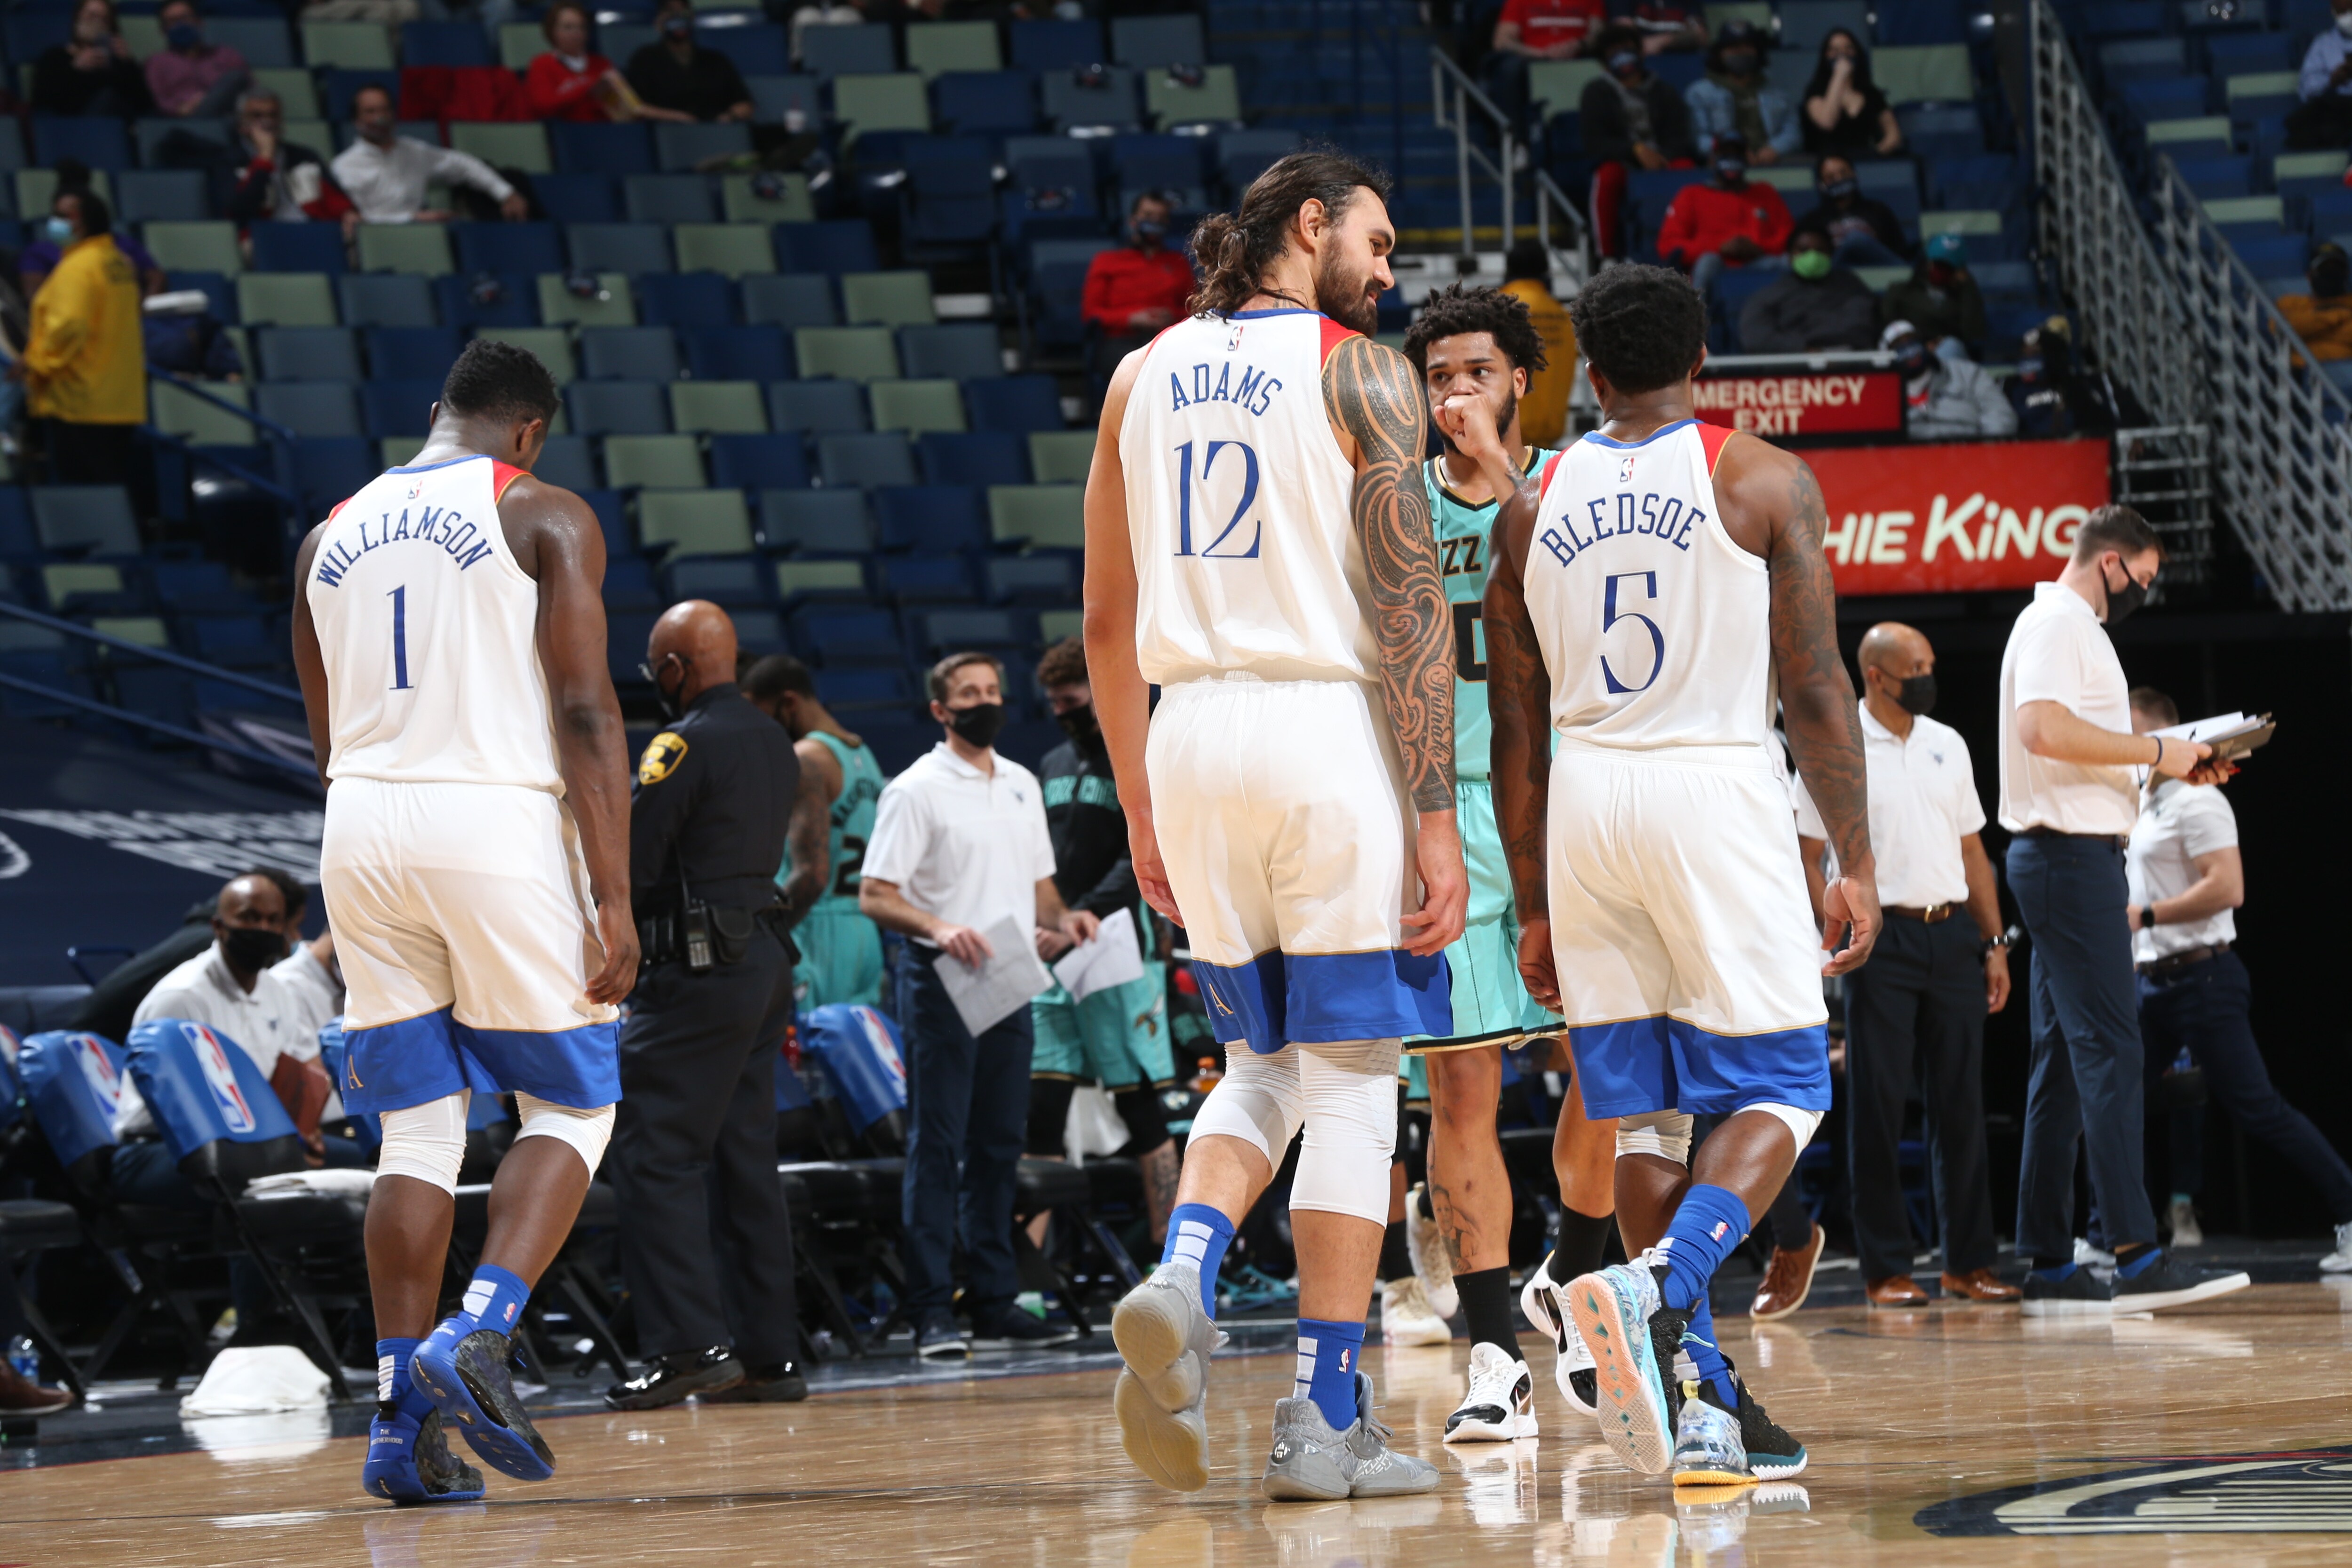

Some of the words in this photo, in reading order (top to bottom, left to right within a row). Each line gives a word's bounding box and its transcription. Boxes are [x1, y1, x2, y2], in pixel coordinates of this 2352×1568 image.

[1170, 361, 1283, 416] ADAMS
[1733, 406, 1804, 436] EXIT
[1173, 439, 1262, 559] 12
[1539, 492, 1707, 568] BLEDSOE
[316, 505, 493, 589] WILLIAMSON
[386, 583, 414, 690] 1
[1598, 569, 1665, 695] 5
